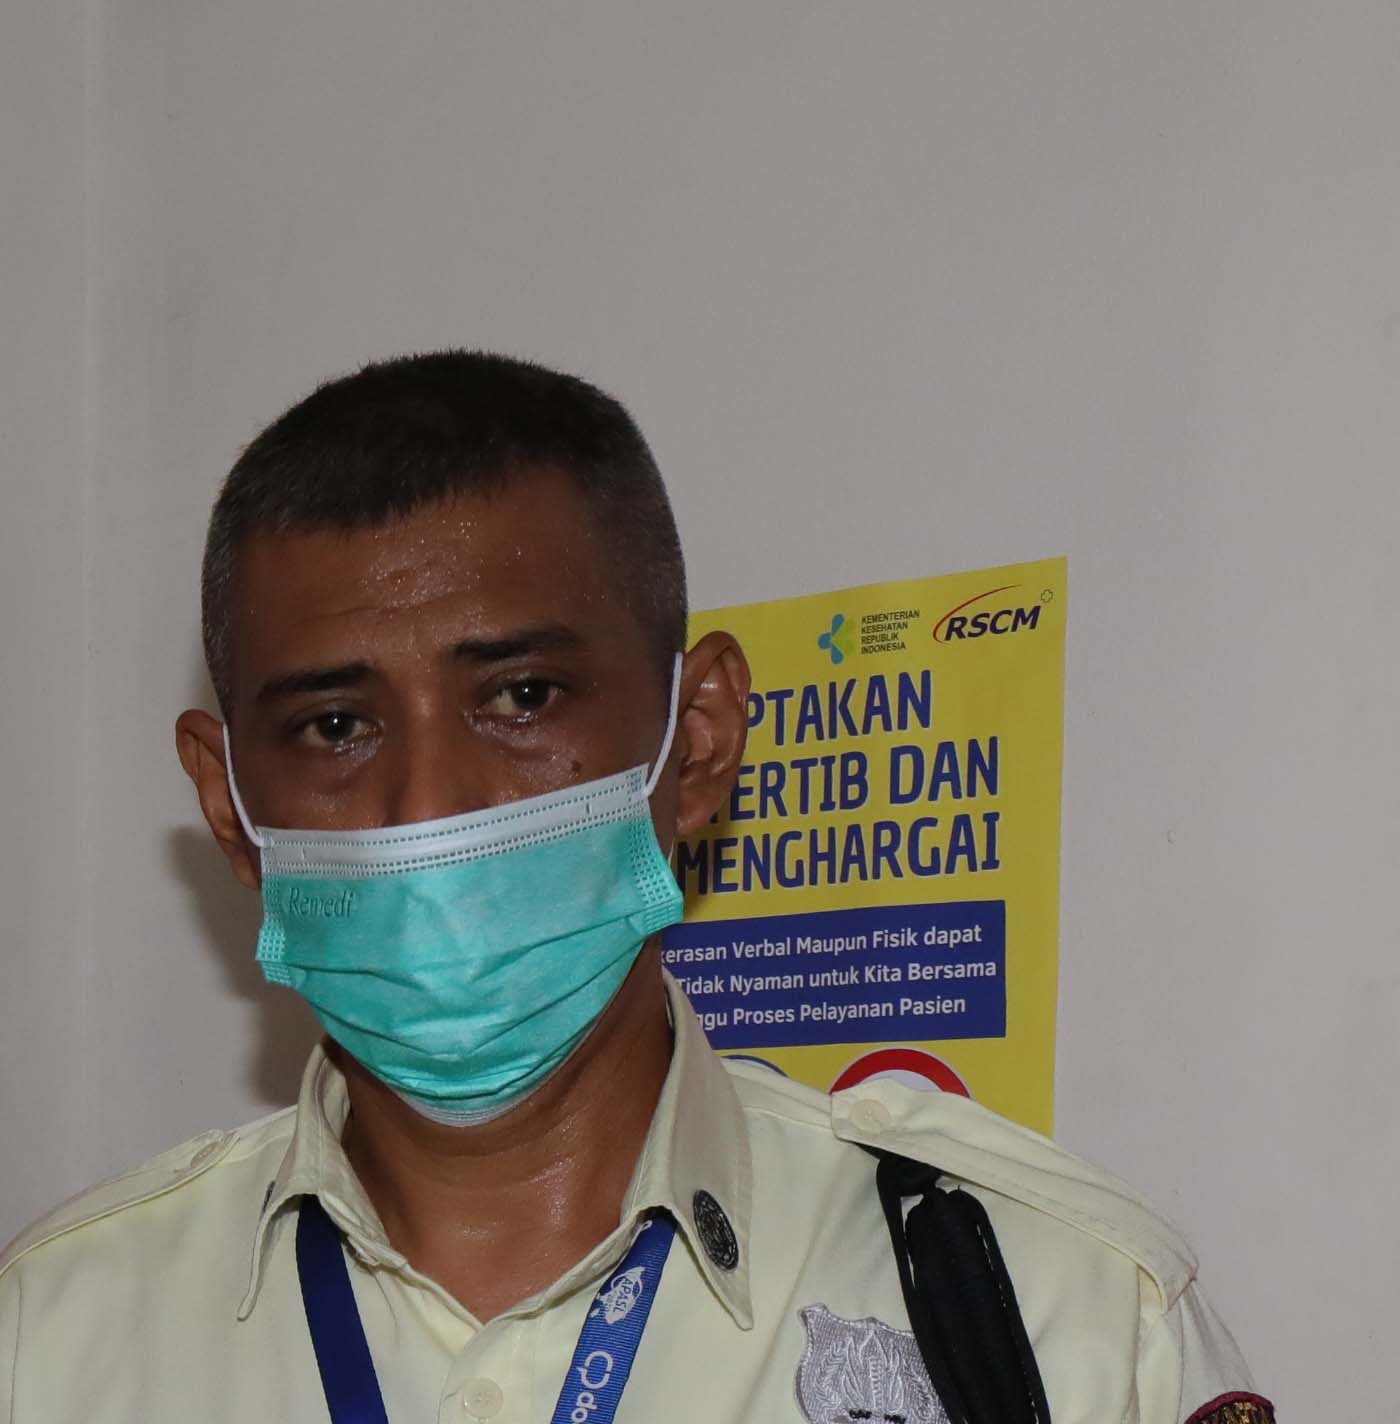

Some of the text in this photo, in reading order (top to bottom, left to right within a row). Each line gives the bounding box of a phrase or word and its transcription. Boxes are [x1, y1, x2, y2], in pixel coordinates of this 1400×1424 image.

[861, 609, 921, 624] KEMENTERIAN
[861, 621, 909, 635] KESEHATAN
[944, 605, 1041, 642] RSCM
[860, 632, 900, 646] REPUBLIK
[860, 641, 907, 656] INDONESIA
[711, 736, 999, 824] ERTIB DAN
[677, 811, 1001, 896] MENGHARGAI
[731, 936, 791, 960] Verbal
[796, 935, 867, 956] Maupun
[872, 927, 919, 949] Fisik
[923, 924, 983, 949] dapat
[729, 973, 805, 997] Nyaman
[808, 966, 860, 988] untuk
[864, 964, 902, 984] Kita
[907, 961, 997, 982] Bersama
[733, 1007, 796, 1026] Proses
[799, 1001, 894, 1024] Pelayanan
[899, 995, 967, 1016] Pasien
